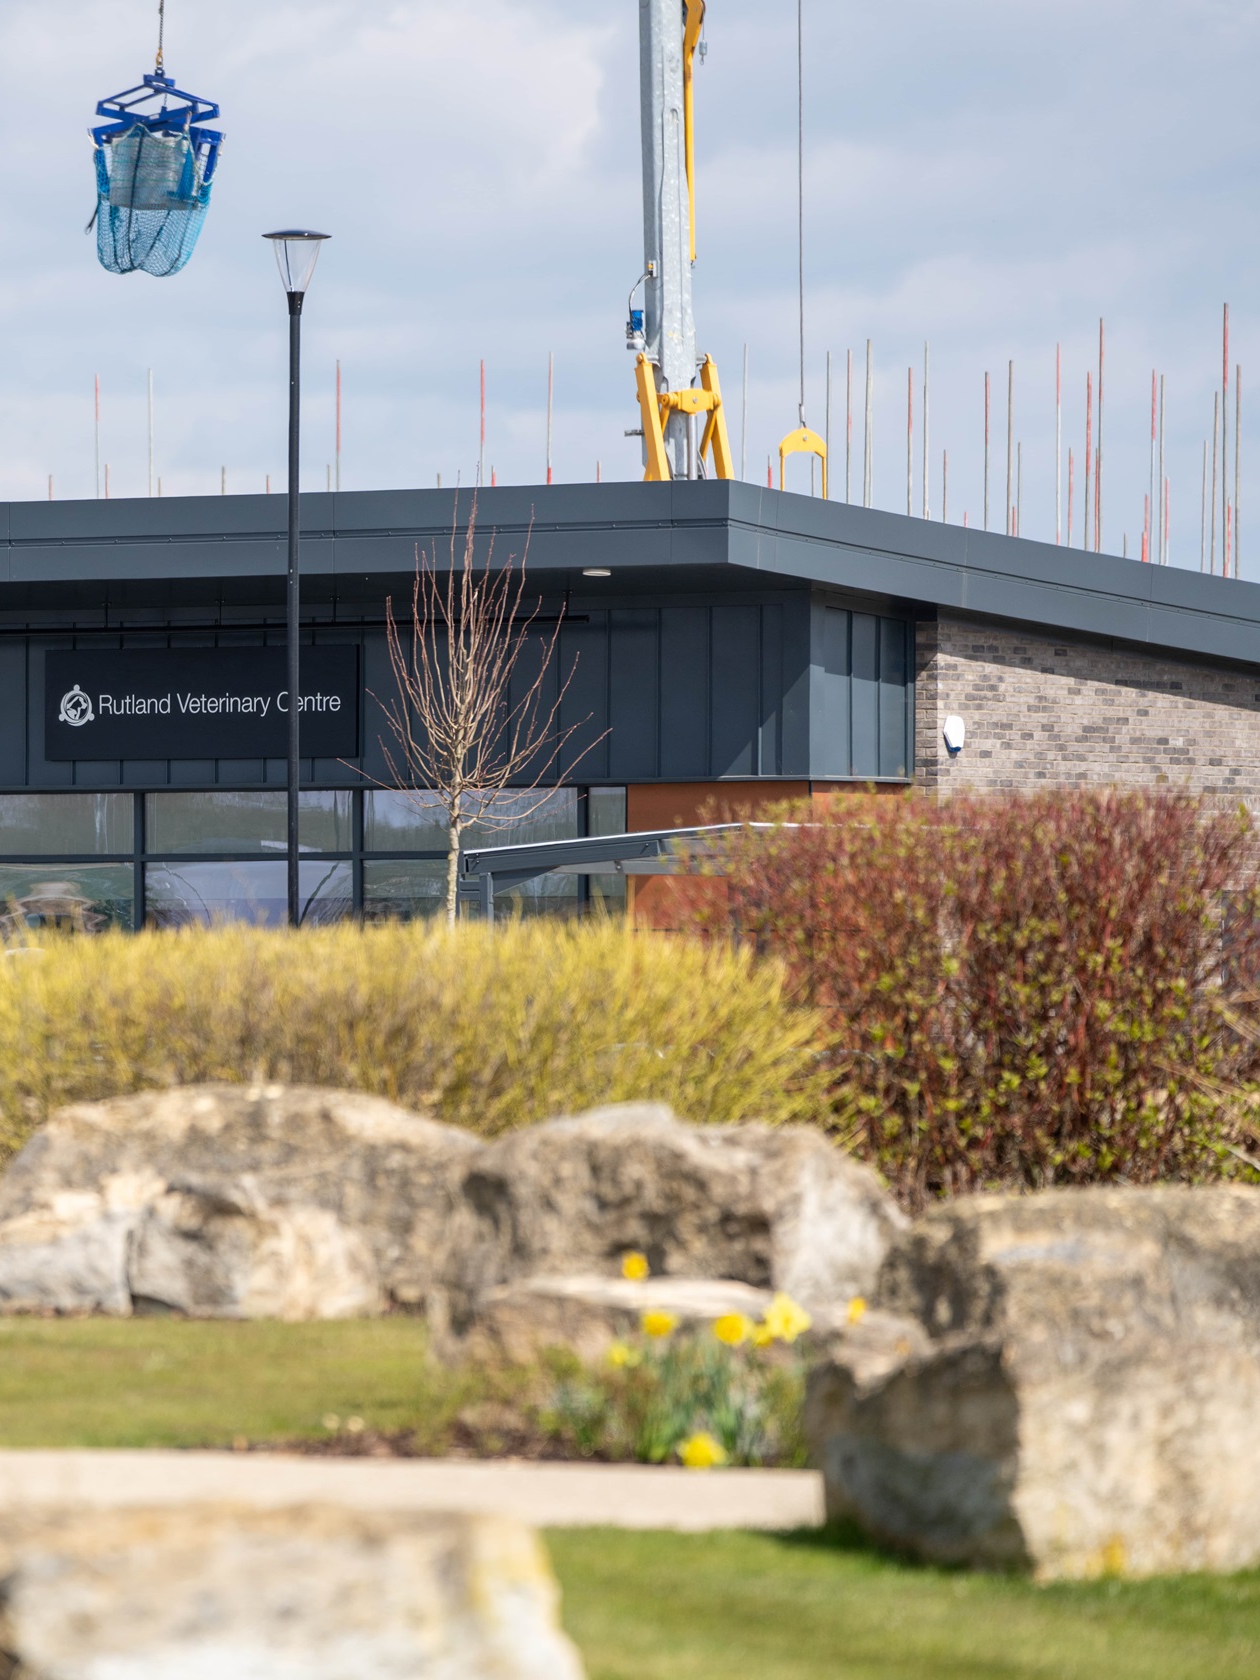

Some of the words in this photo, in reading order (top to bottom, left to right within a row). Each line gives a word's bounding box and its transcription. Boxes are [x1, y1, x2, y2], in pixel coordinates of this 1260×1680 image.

[98, 693, 171, 715] Rutland
[176, 692, 271, 716] Veterinary
[276, 691, 341, 712] Centre
